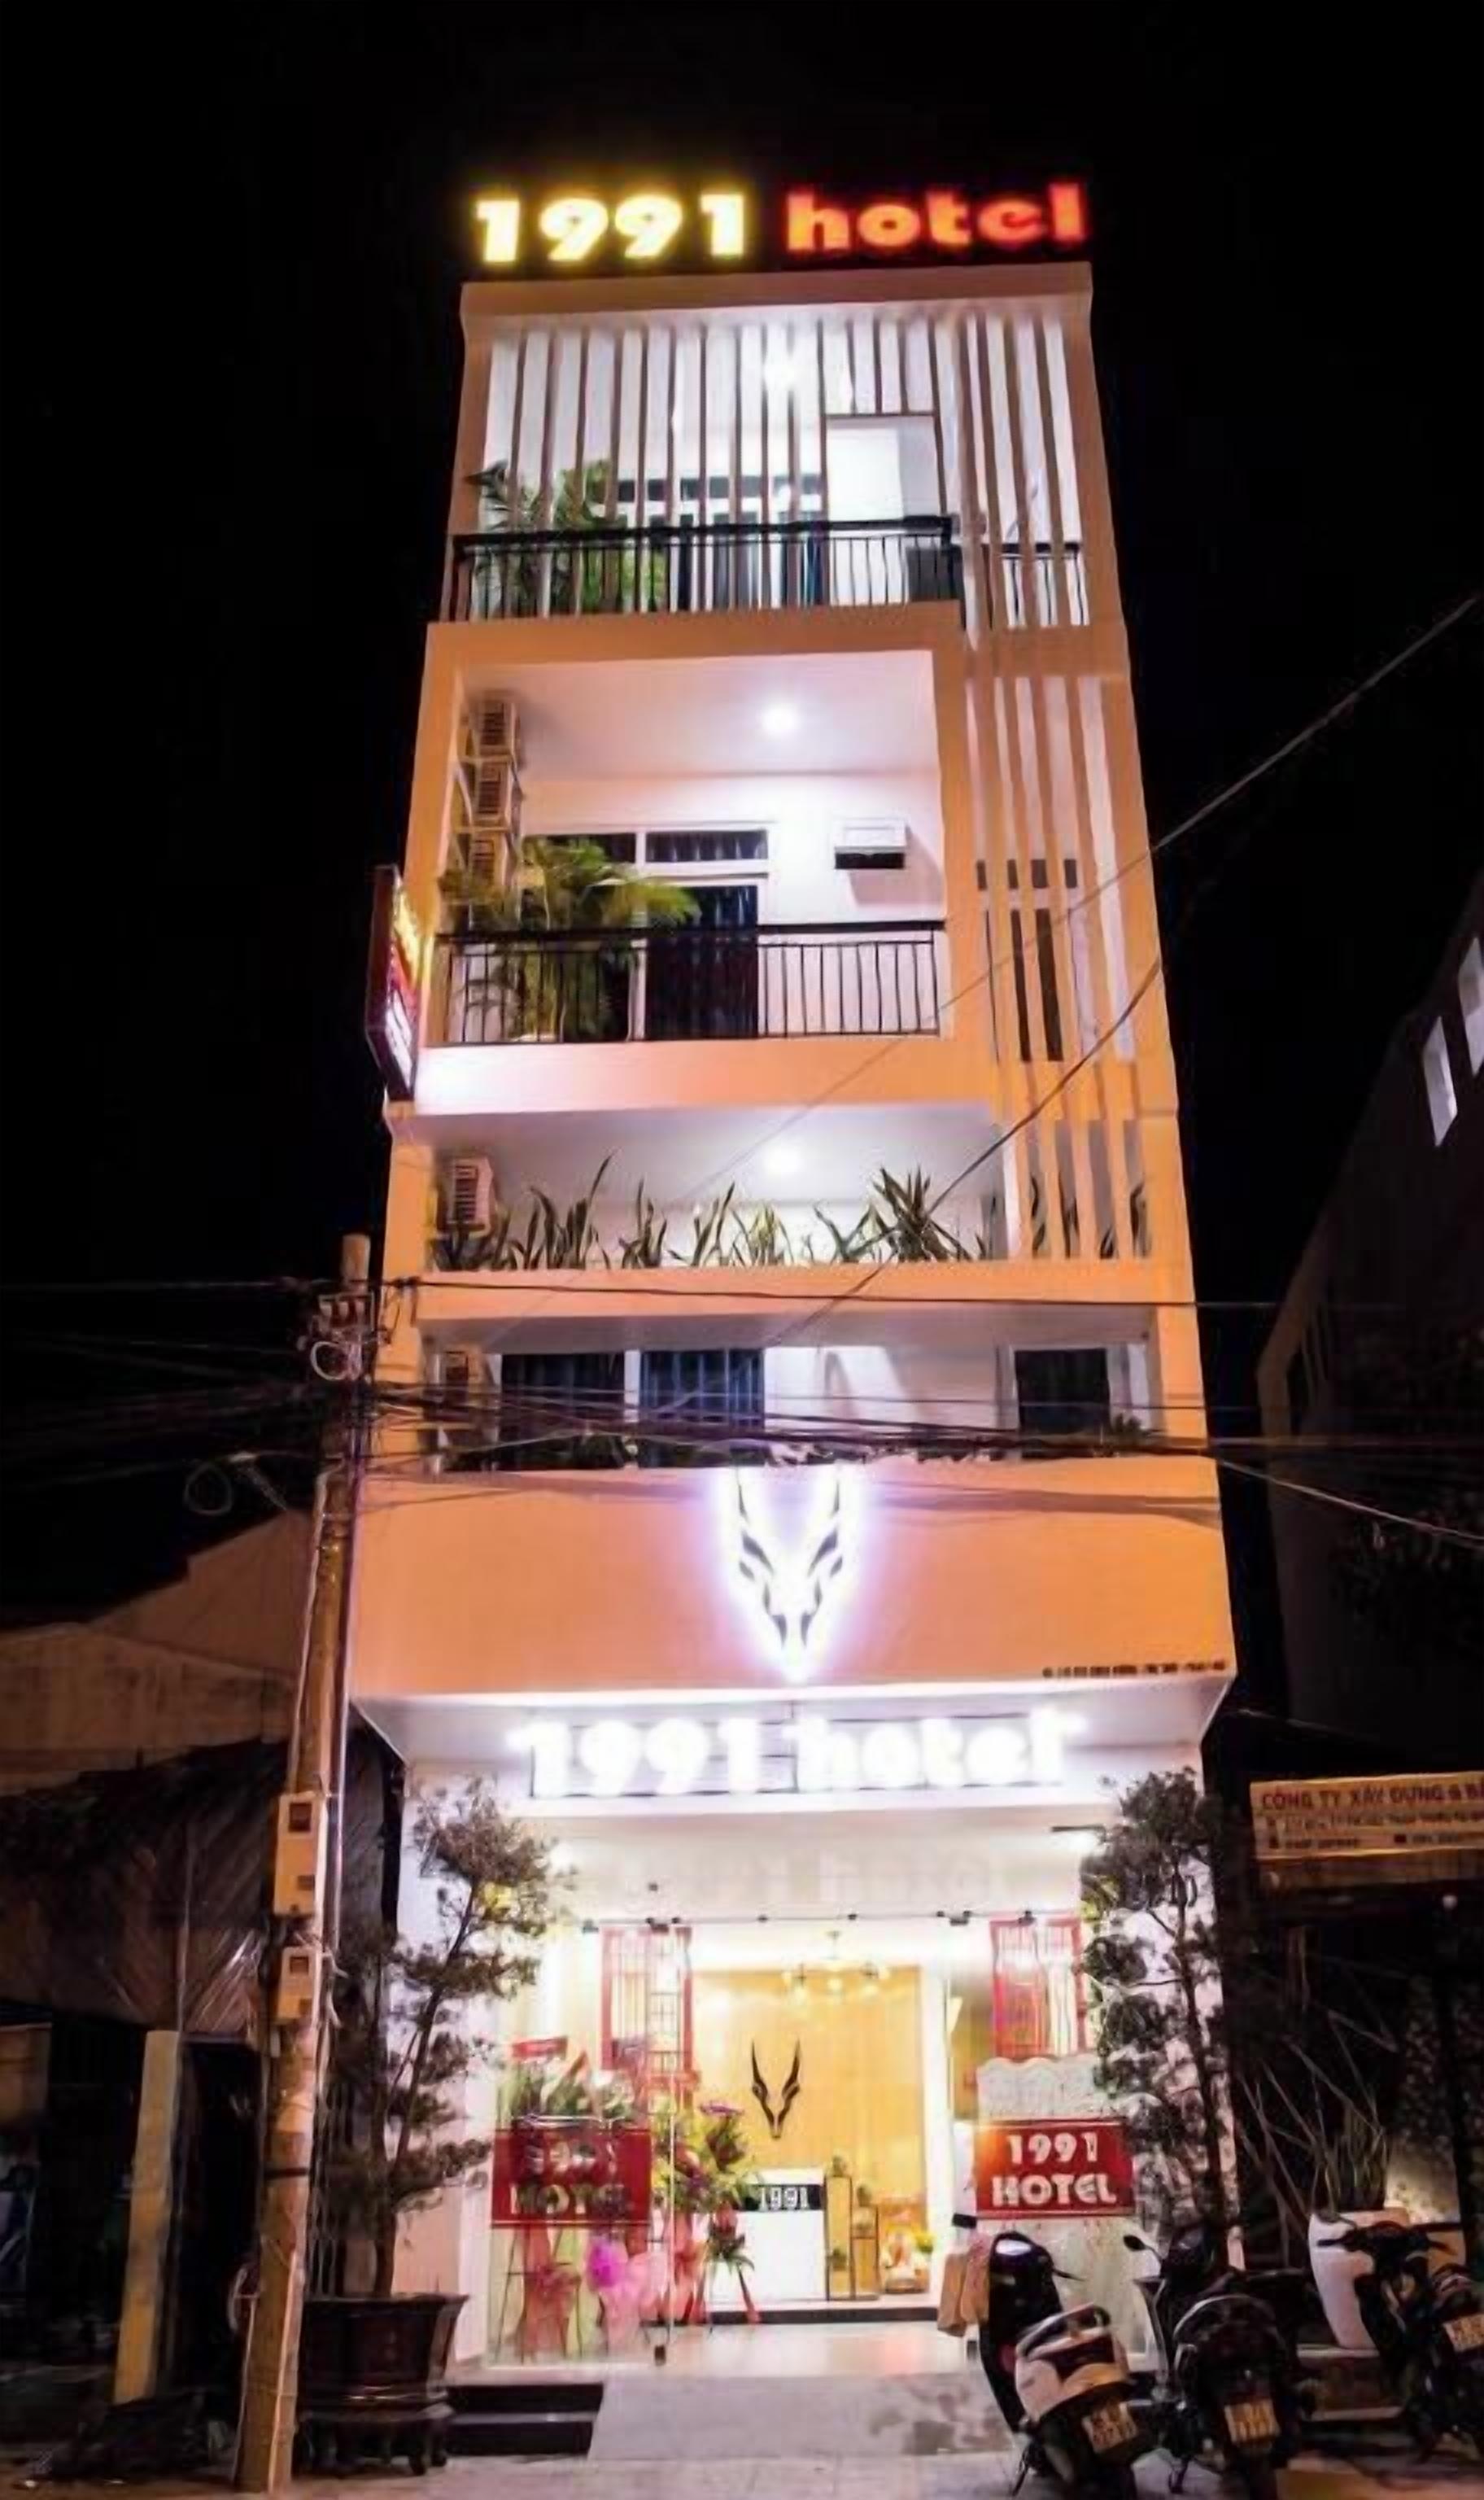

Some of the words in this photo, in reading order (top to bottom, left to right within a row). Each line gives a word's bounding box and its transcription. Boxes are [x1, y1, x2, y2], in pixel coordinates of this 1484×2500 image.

[474, 192, 746, 264] 1991
[786, 184, 1087, 252] hotel
[522, 1717, 760, 1797] 1991
[792, 1707, 1064, 1790] hotel
[1007, 2132, 1098, 2165] 1991
[509, 2183, 635, 2215] HOT
[759, 2187, 808, 2211] 1991
[992, 2174, 1117, 2207] HOTEL
